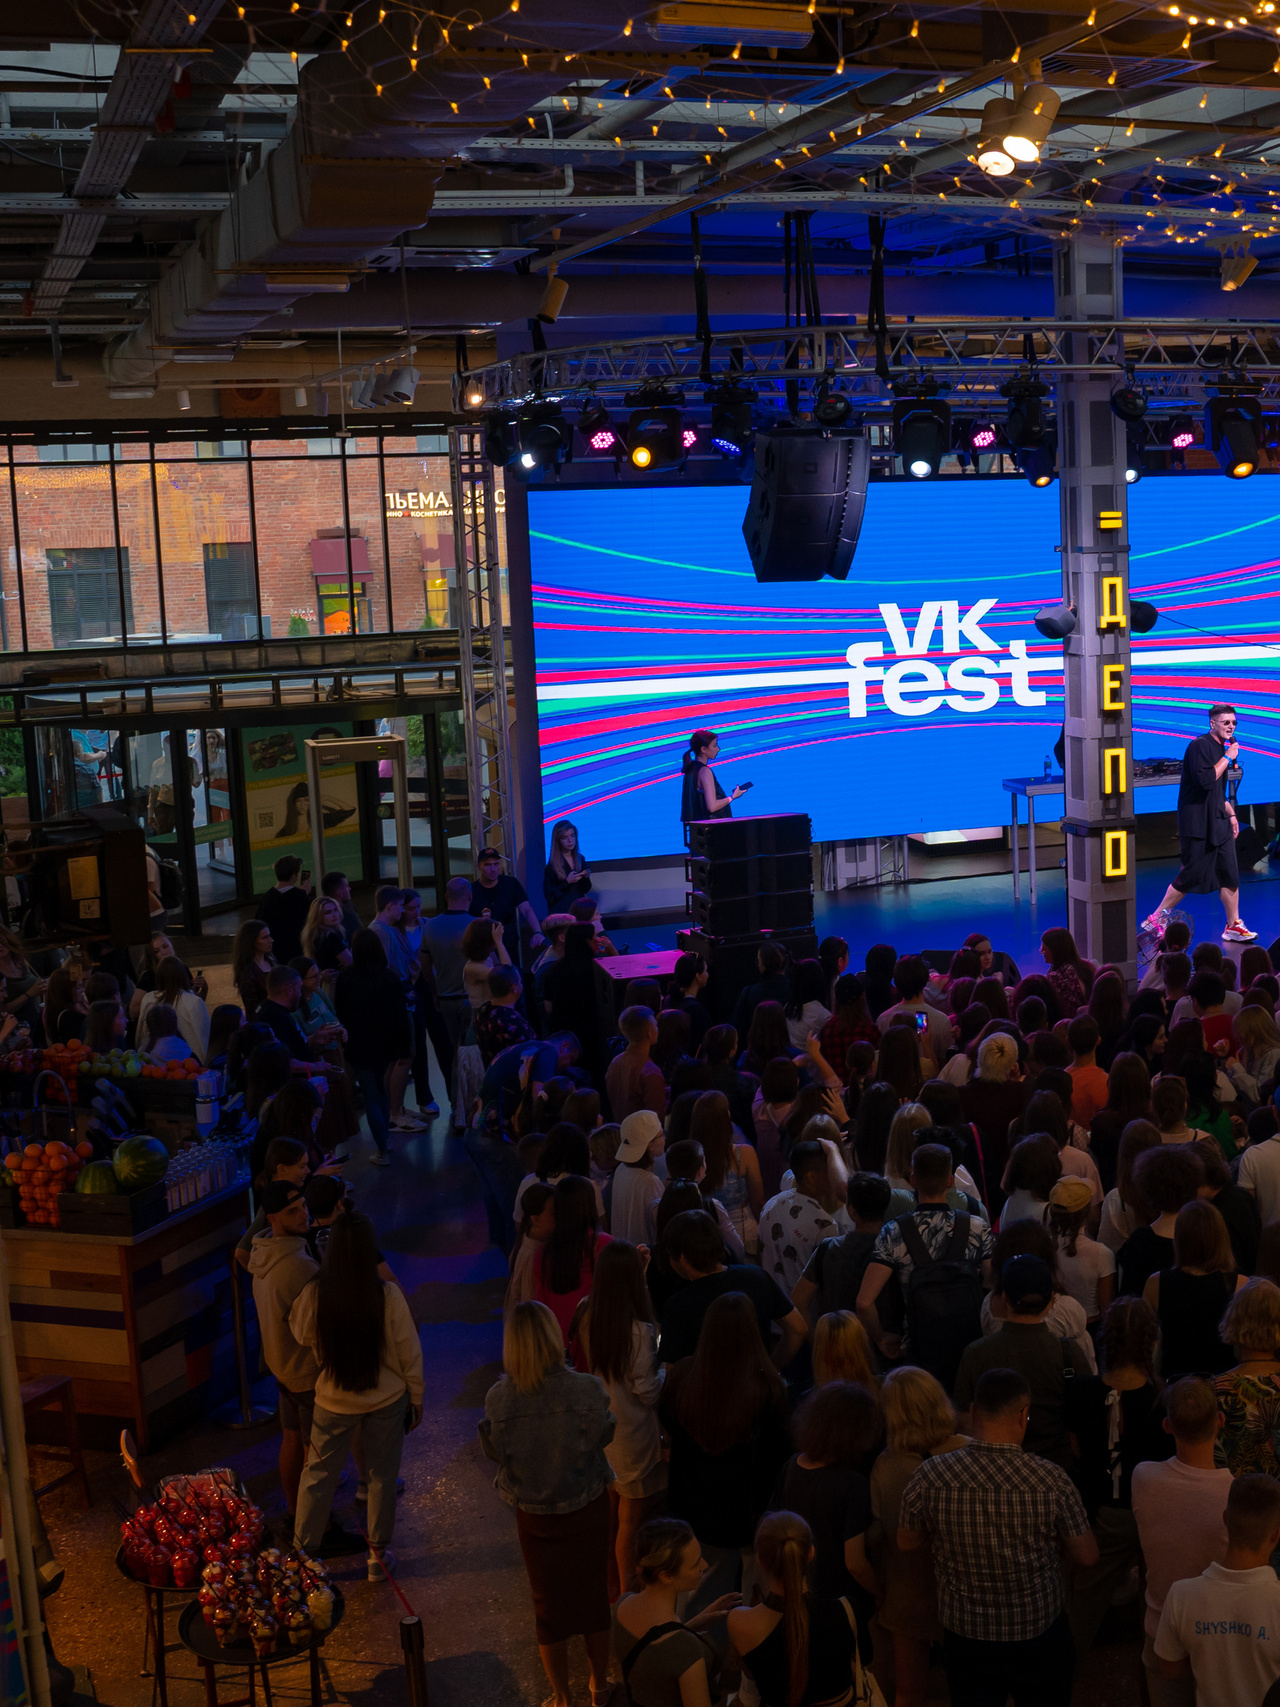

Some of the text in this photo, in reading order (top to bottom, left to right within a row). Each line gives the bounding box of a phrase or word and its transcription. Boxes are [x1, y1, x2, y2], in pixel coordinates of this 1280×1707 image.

[878, 598, 1003, 656] VK
[846, 640, 1047, 718] fest
[1195, 1621, 1270, 1641] SHYSHKO A.
